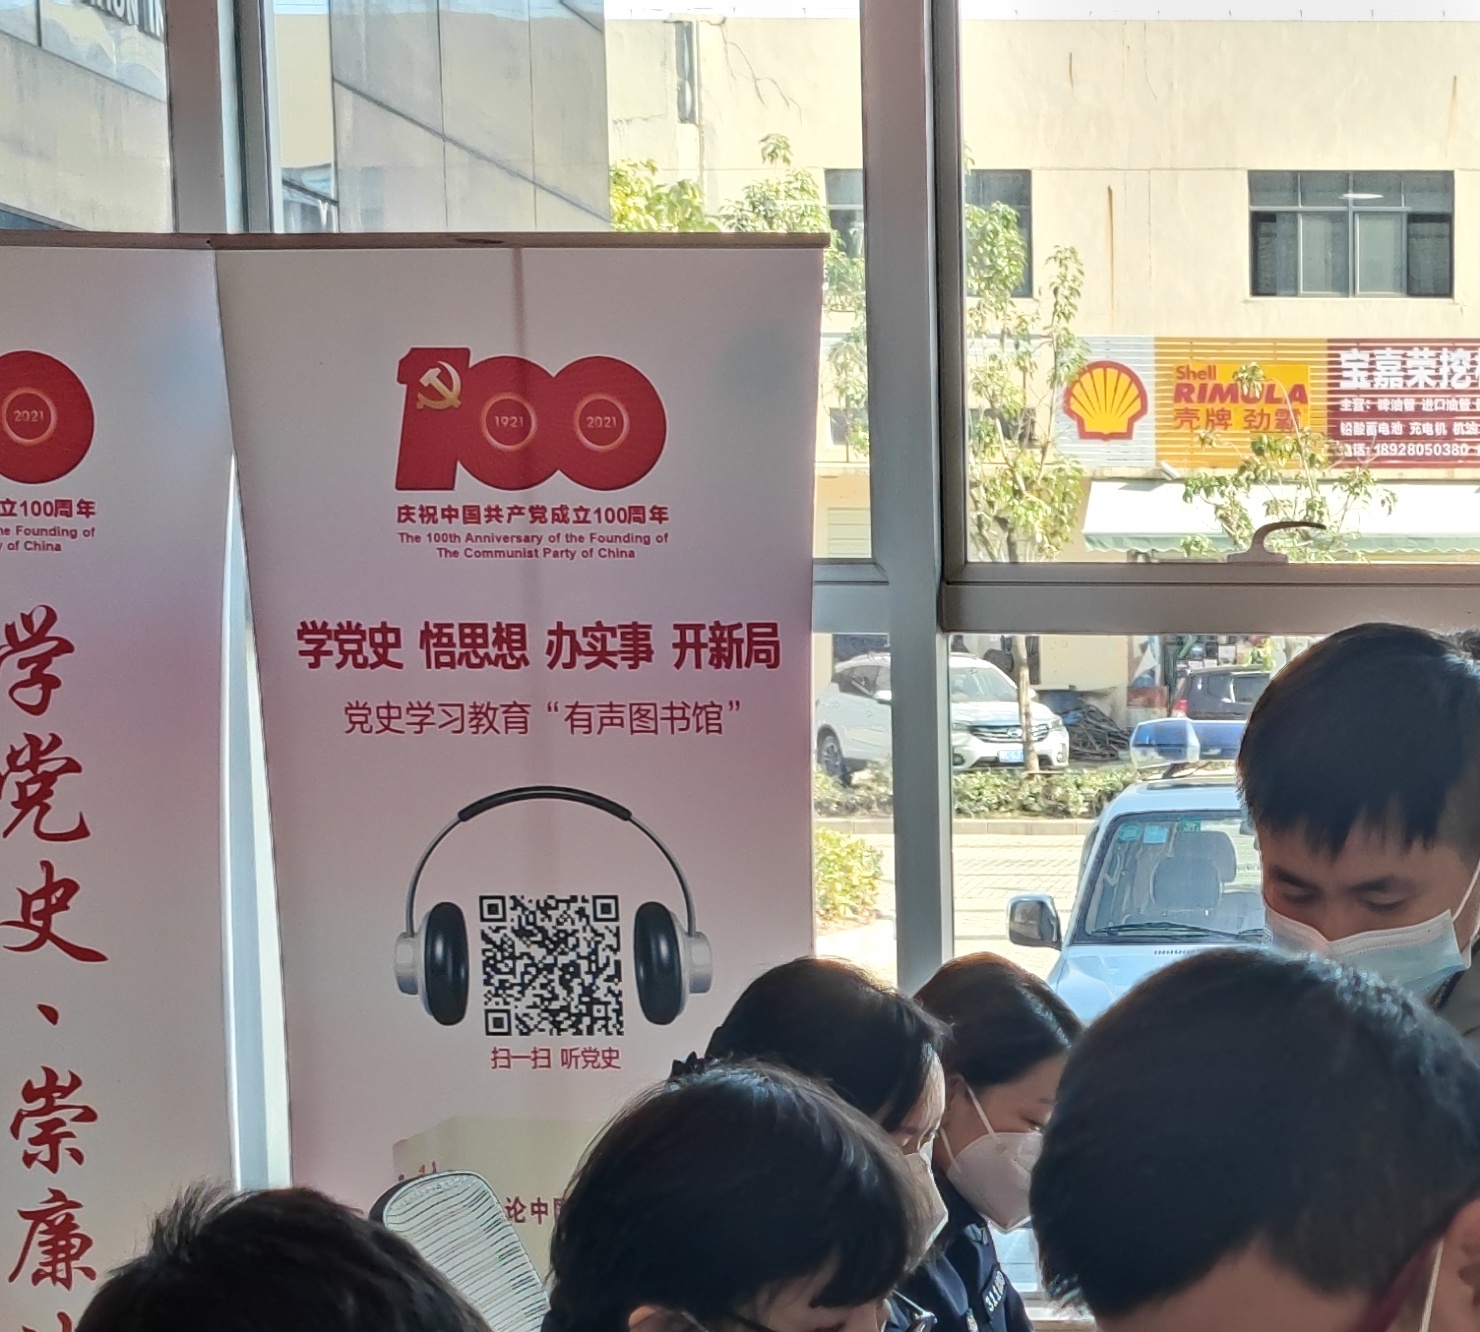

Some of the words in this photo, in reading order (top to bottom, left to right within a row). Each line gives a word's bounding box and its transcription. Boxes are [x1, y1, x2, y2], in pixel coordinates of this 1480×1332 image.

[1176, 365, 1217, 381] Shell
[1173, 383, 1309, 405] RIMULA
[12, 409, 45, 422] 2021
[493, 415, 525, 428] 1921
[585, 416, 617, 429] 2021
[1174, 407, 1233, 431] 壳牌
[396, 504, 670, 525] 庆祝中国共产党成立100周年
[15, 525, 78, 539] Founding
[82, 526, 96, 538] of
[399, 531, 421, 543] The
[427, 531, 462, 544] 100th
[465, 532, 543, 546] Anniversary
[548, 532, 561, 544] of
[565, 532, 585, 544] the
[589, 532, 651, 546] Founding
[656, 532, 670, 544] of
[8, 540, 20, 551] of
[24, 540, 62, 552] China
[437, 547, 459, 559] The
[464, 547, 539, 559] Communist
[543, 547, 576, 561] Party
[581, 547, 594, 559] of
[598, 547, 636, 559] China
[297, 620, 404, 670] 学党史
[420, 620, 531, 670] 悟思想
[545, 621, 655, 670] 办实事
[672, 622, 781, 670] 开新局
[490, 1046, 552, 1070] 扫一扫
[560, 1046, 622, 1070] 听党史
